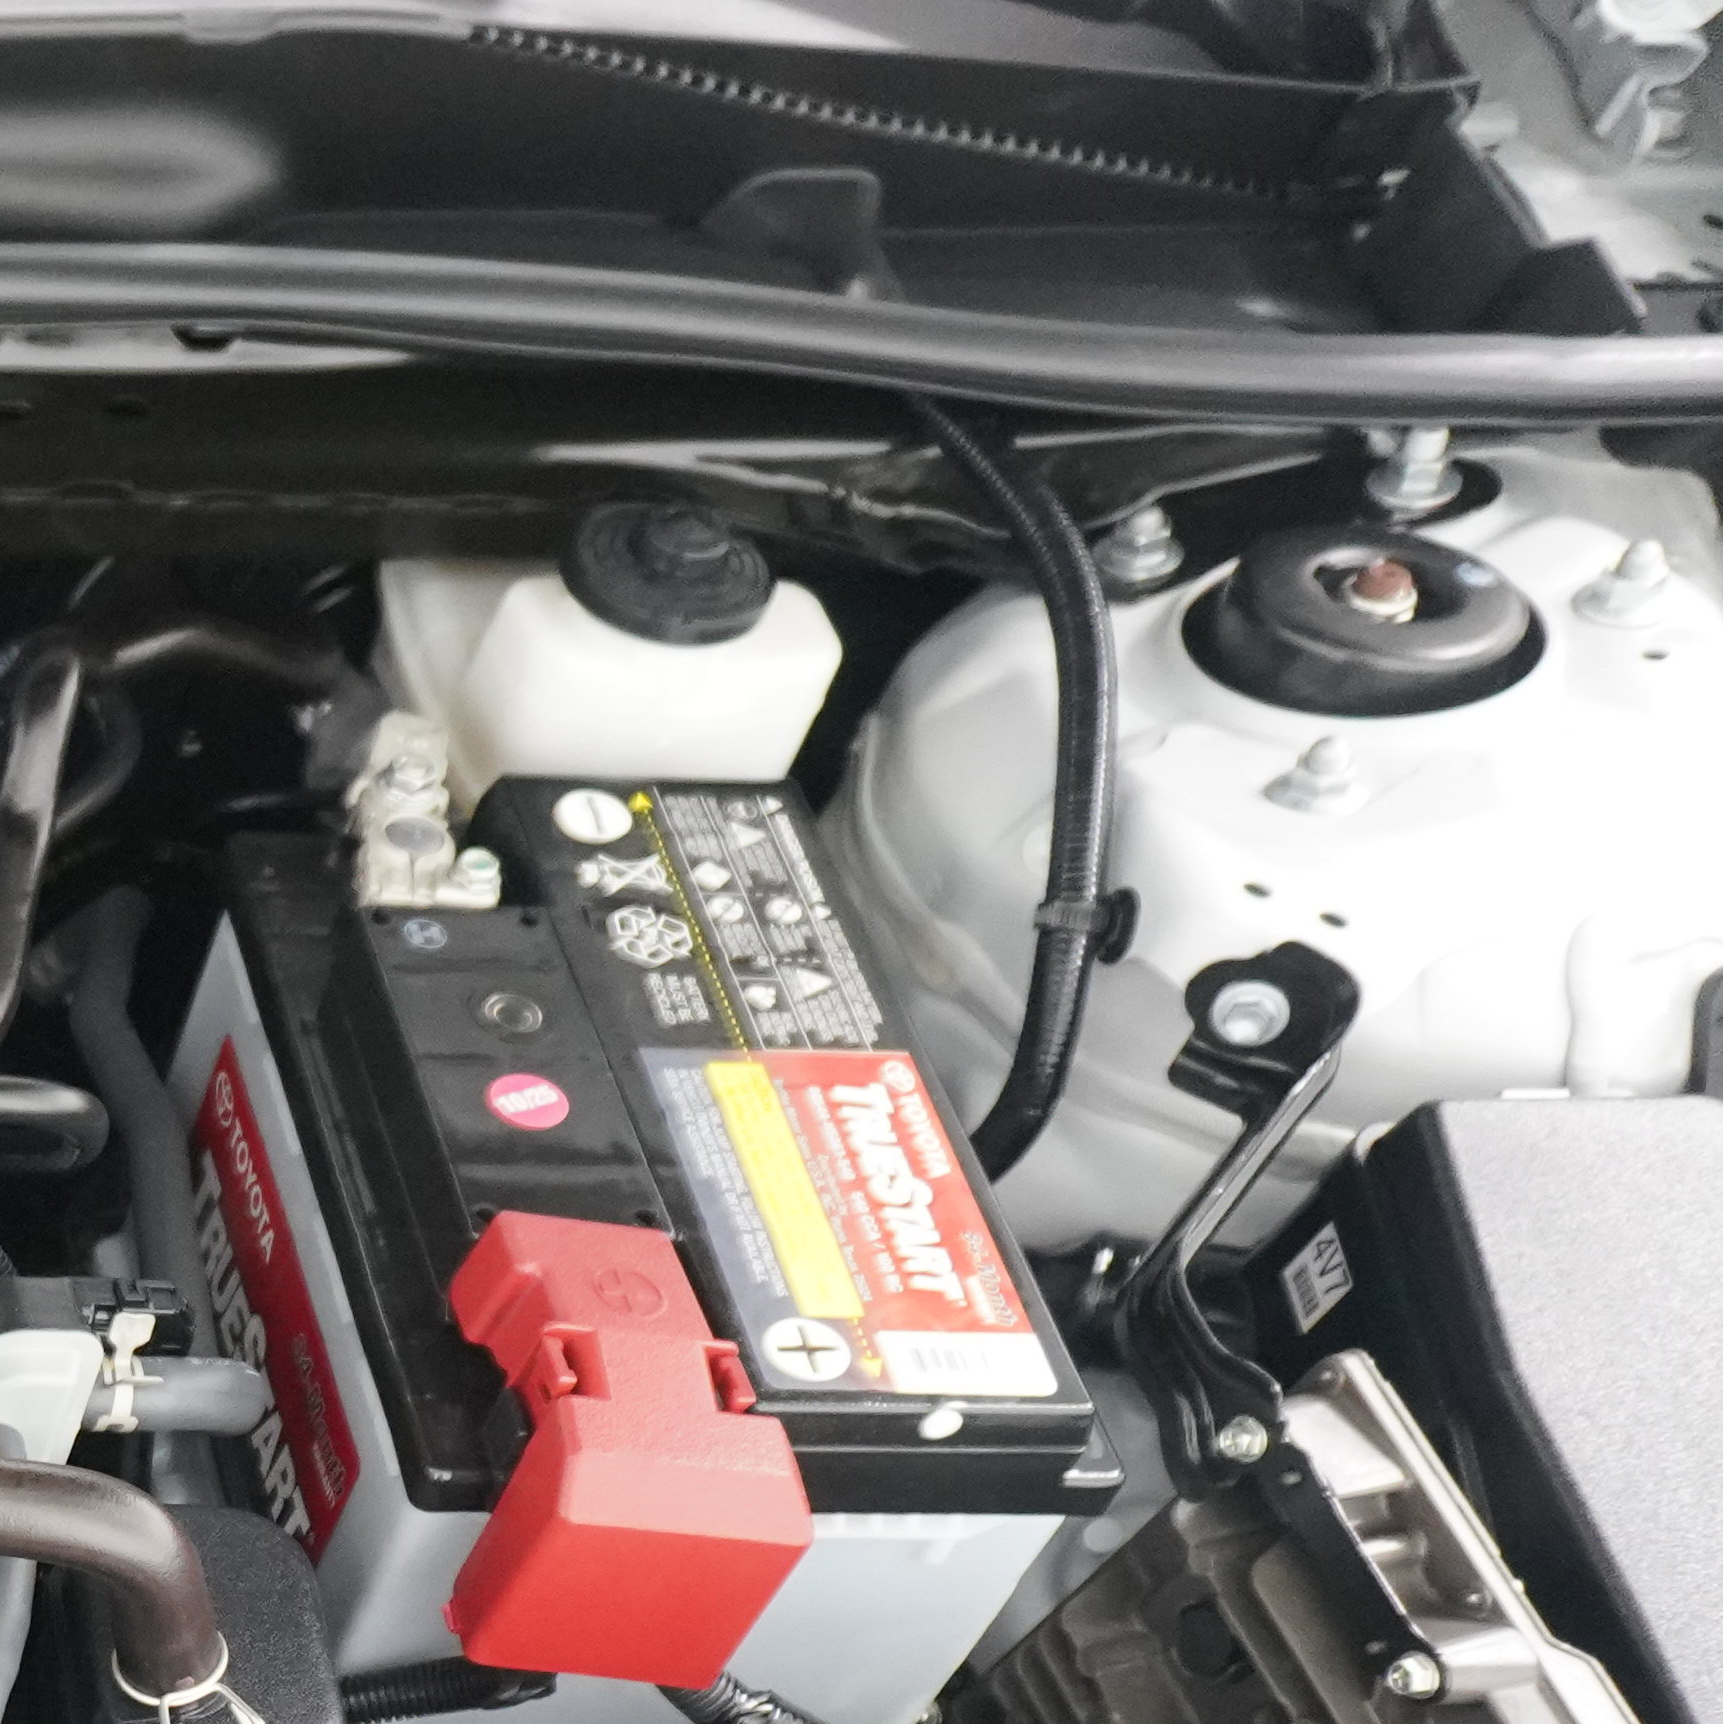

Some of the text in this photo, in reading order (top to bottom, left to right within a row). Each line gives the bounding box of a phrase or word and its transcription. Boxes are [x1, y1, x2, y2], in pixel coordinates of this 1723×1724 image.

[494, 1084, 560, 1115] 10/25
[895, 1094, 952, 1177] TOYOTA
[229, 1115, 276, 1266] TOYOTA
[1311, 1237, 1351, 1296] 4V7
[195, 1149, 312, 1538] TRUESART
